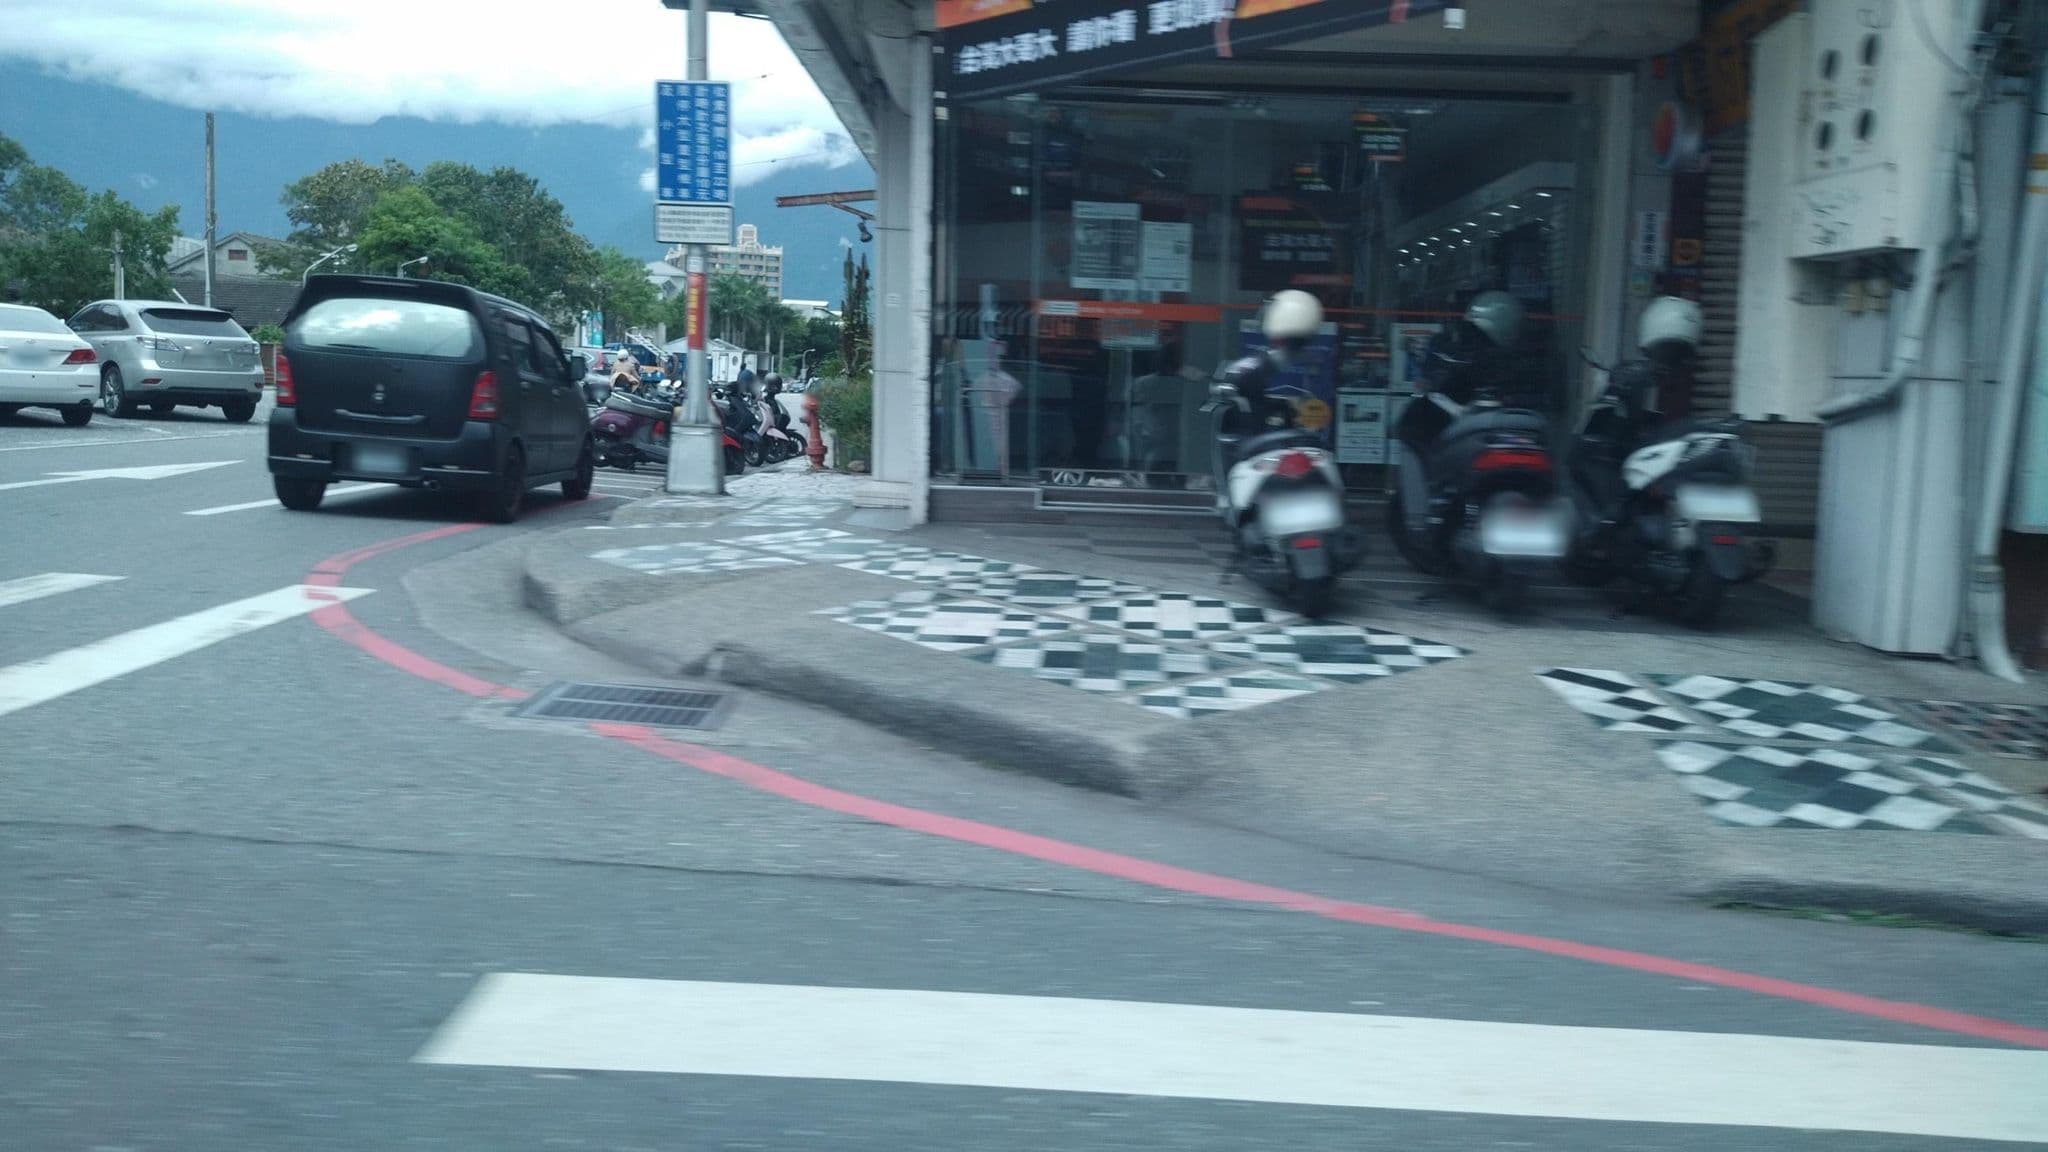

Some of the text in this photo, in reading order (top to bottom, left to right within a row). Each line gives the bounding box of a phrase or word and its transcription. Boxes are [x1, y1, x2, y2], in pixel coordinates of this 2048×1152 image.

[957, 28, 1060, 74] 台灣大哥大
